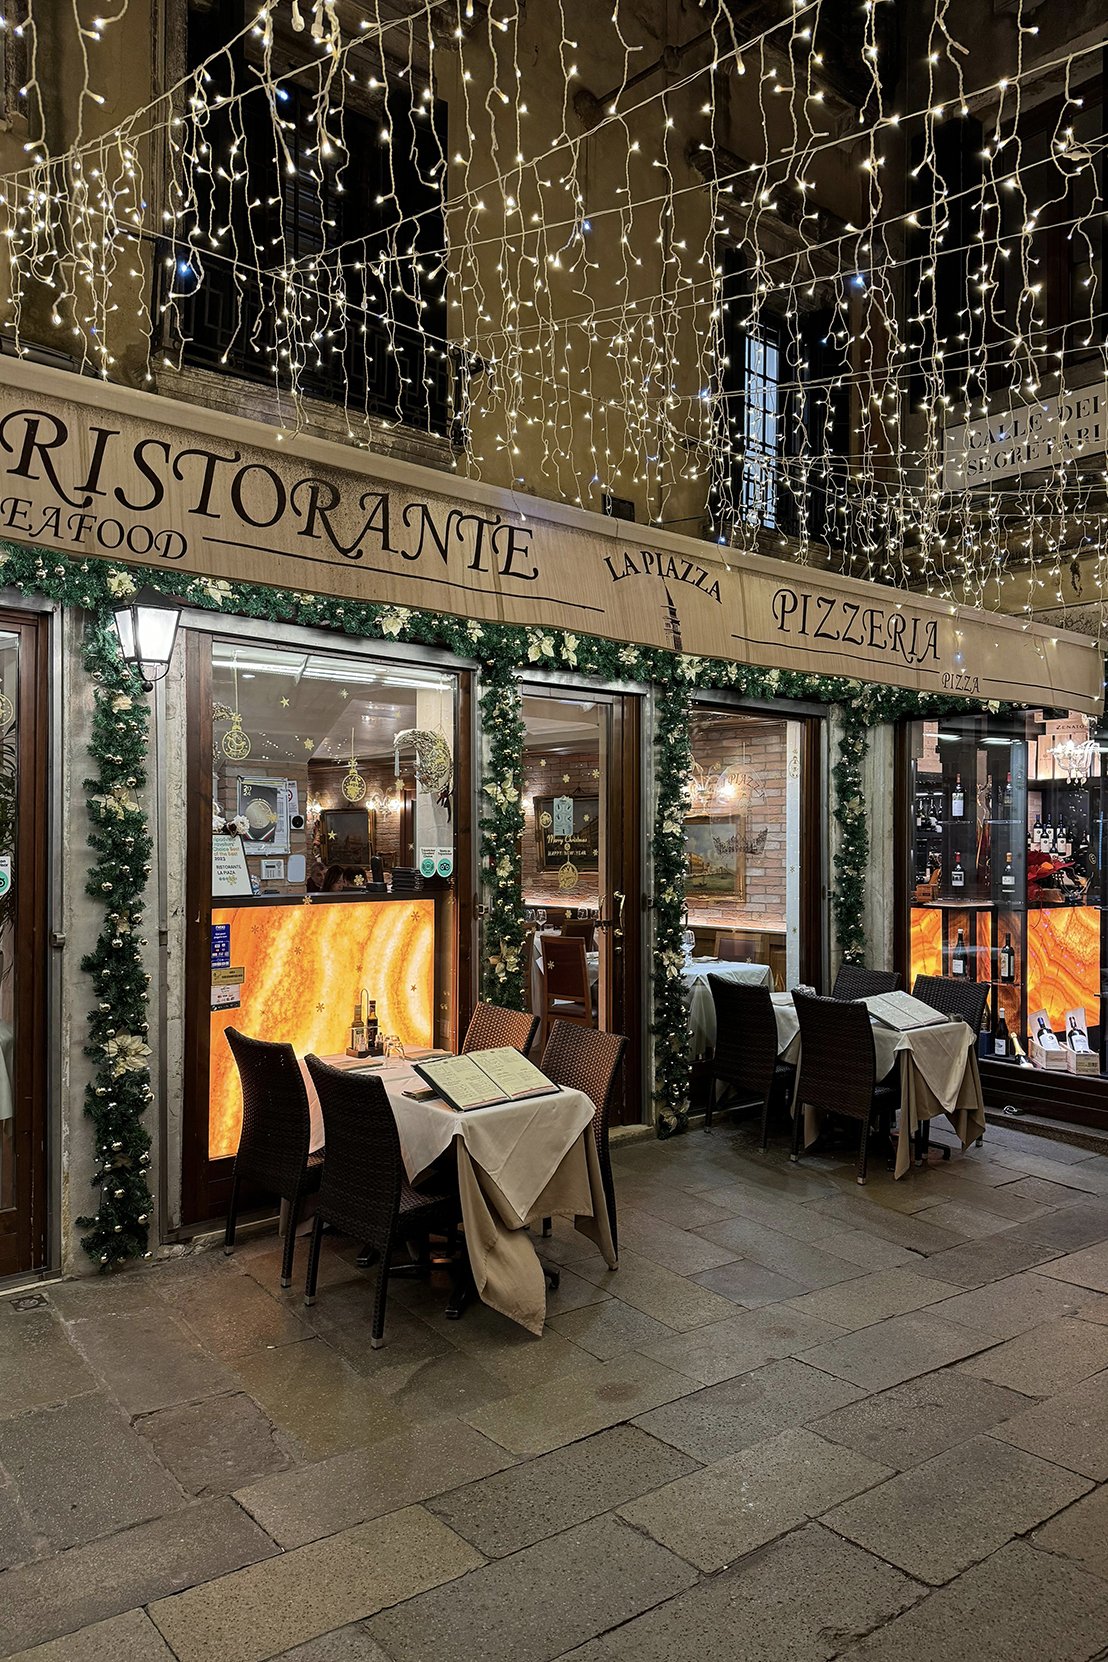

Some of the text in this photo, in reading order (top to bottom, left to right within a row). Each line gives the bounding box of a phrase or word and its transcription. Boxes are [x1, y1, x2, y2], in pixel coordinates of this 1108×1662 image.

[969, 395, 1100, 449] CALLE DEI
[0, 409, 539, 580] RISTORANTE
[603, 551, 723, 605] LA PIAZZA
[771, 588, 941, 664] PIZZERIA
[941, 672, 980, 695] PIZZA
